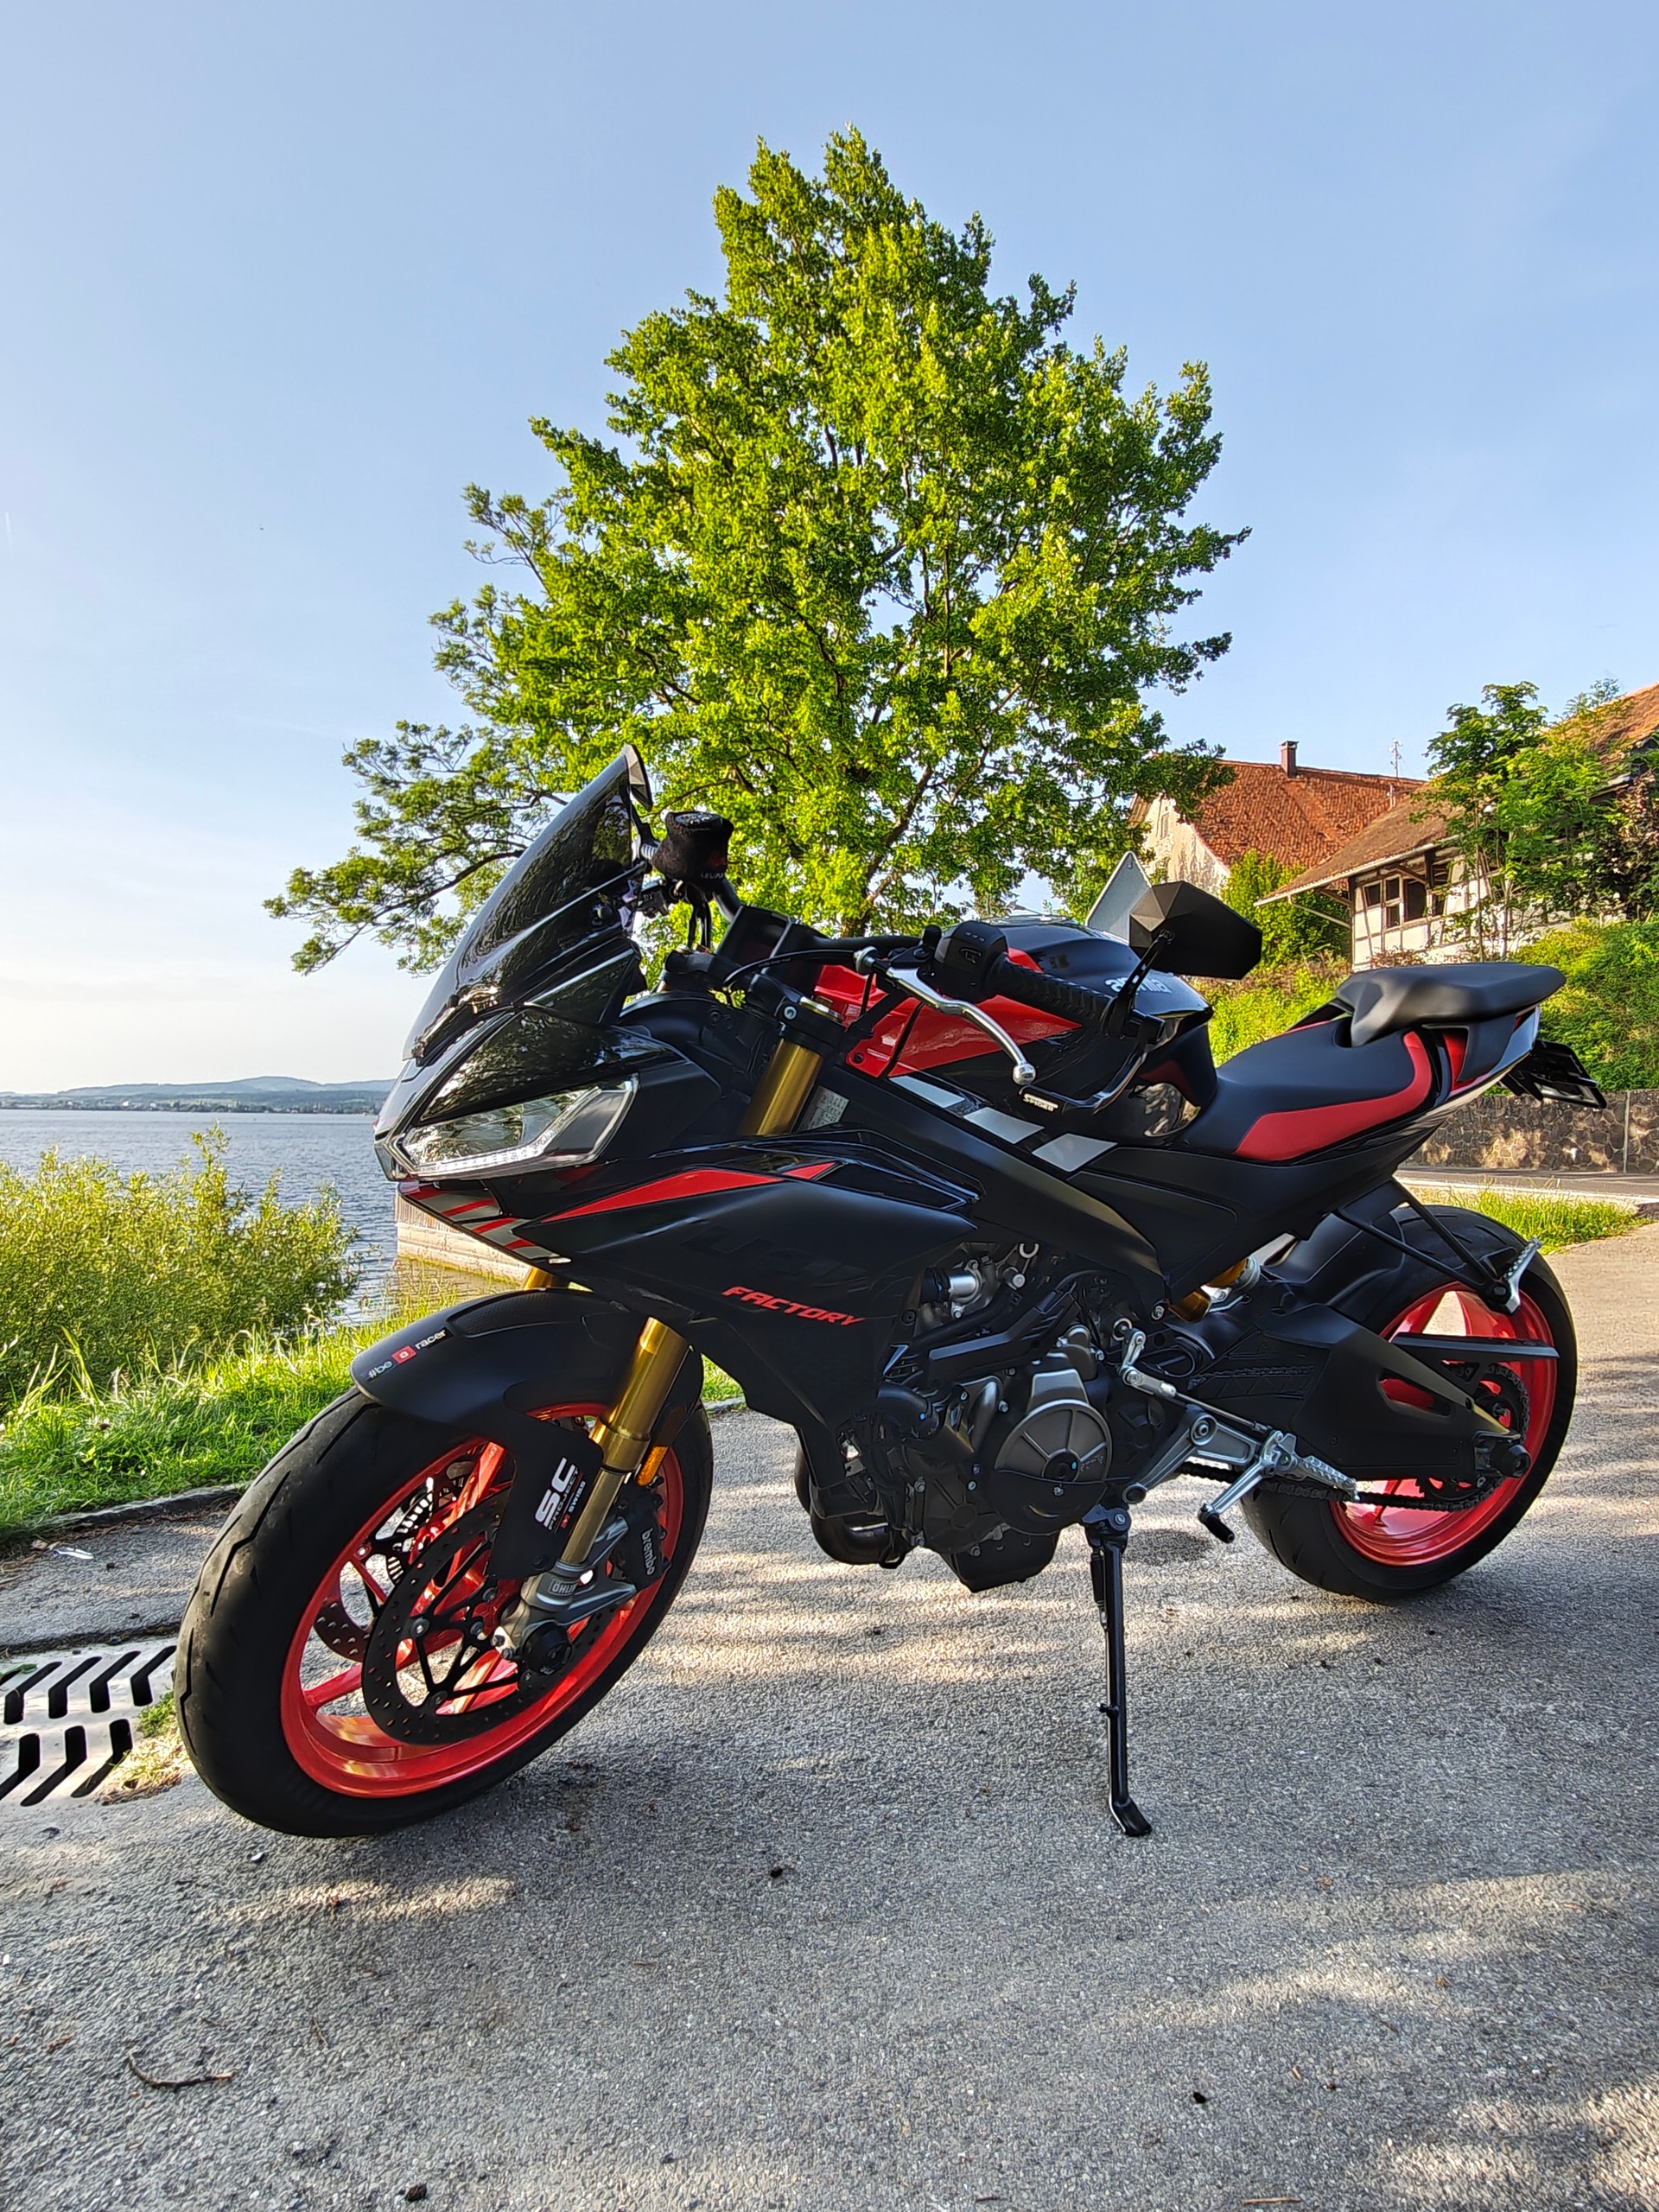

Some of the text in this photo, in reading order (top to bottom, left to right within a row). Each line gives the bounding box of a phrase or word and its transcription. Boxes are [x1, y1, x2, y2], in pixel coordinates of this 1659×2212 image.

[721, 1286, 865, 1326] FACTORY
[367, 1361, 393, 1379] #be
[415, 1329, 446, 1350] racer
[535, 1457, 576, 1528] SC
[641, 1527, 658, 1576] brembo
